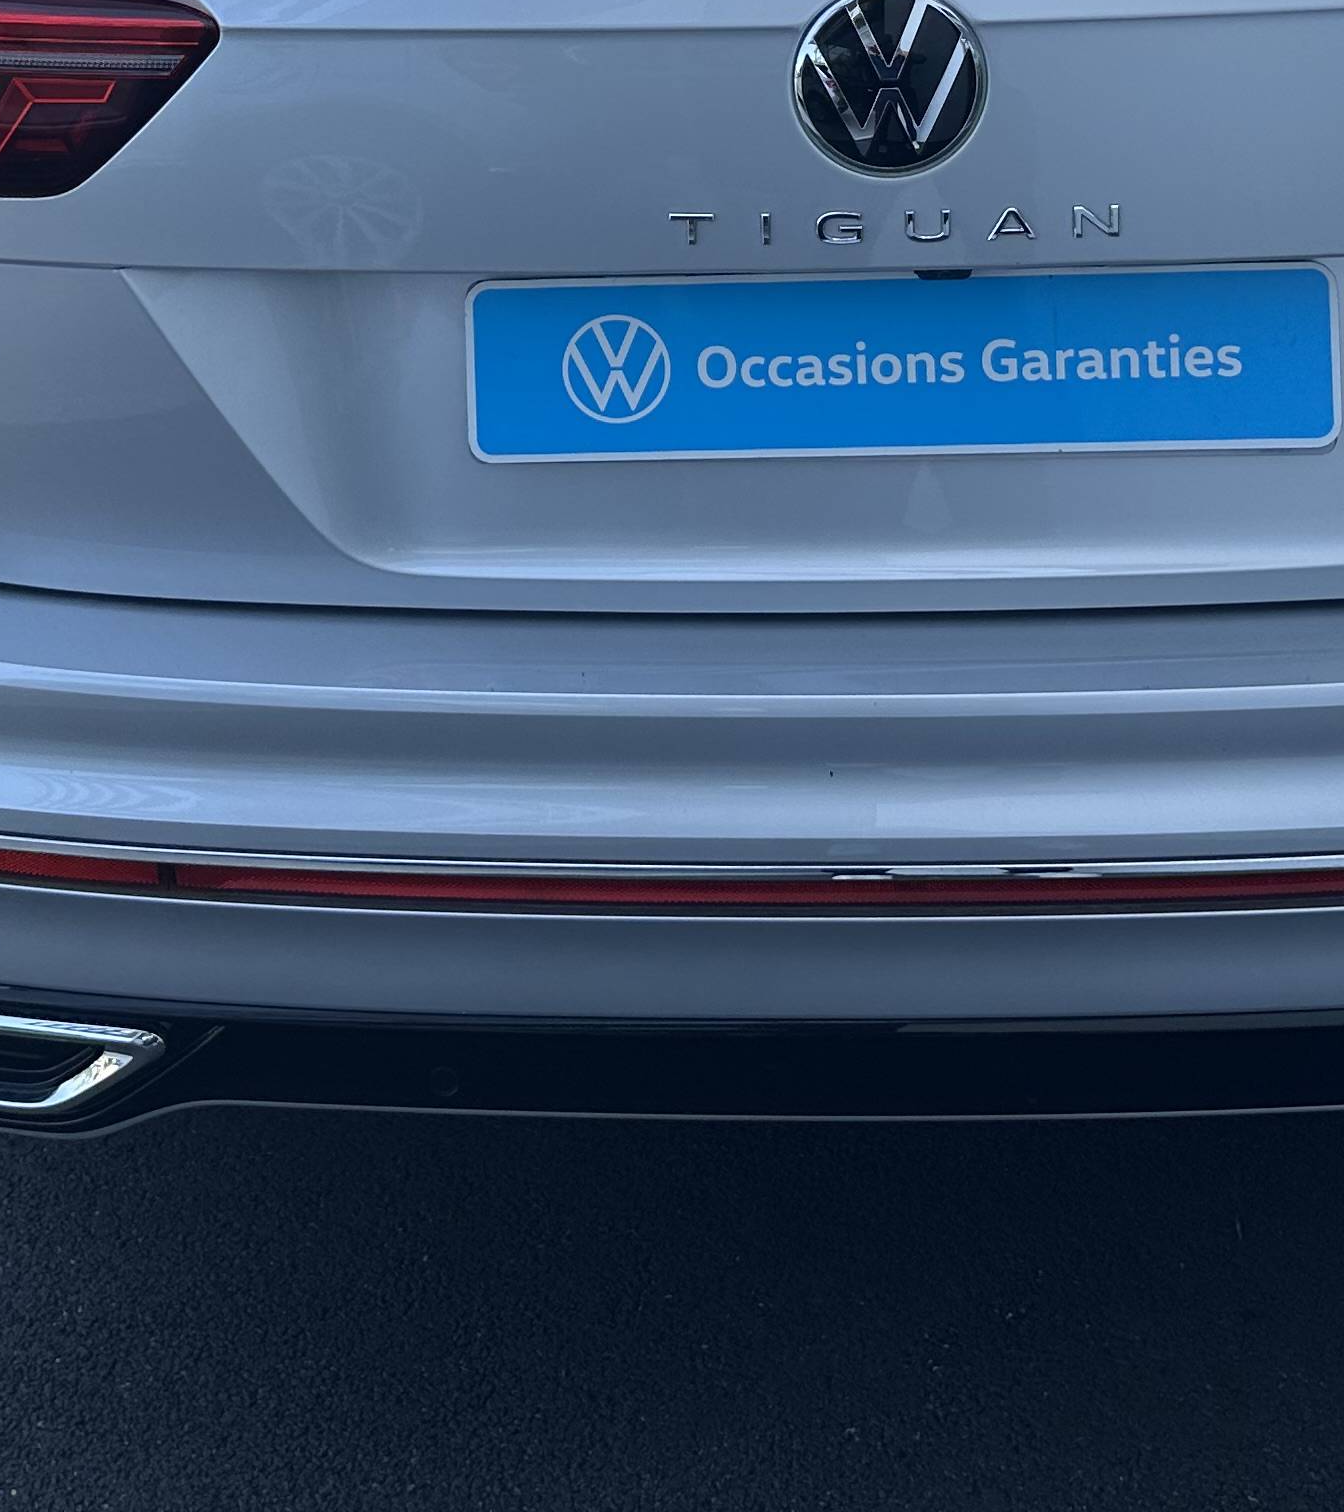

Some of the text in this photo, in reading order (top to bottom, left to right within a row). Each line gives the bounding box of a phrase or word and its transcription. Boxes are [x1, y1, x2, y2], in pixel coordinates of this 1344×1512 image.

[668, 202, 1121, 246] TIGUAN
[697, 341, 965, 389] Occasions
[981, 334, 1243, 384] Garanties
